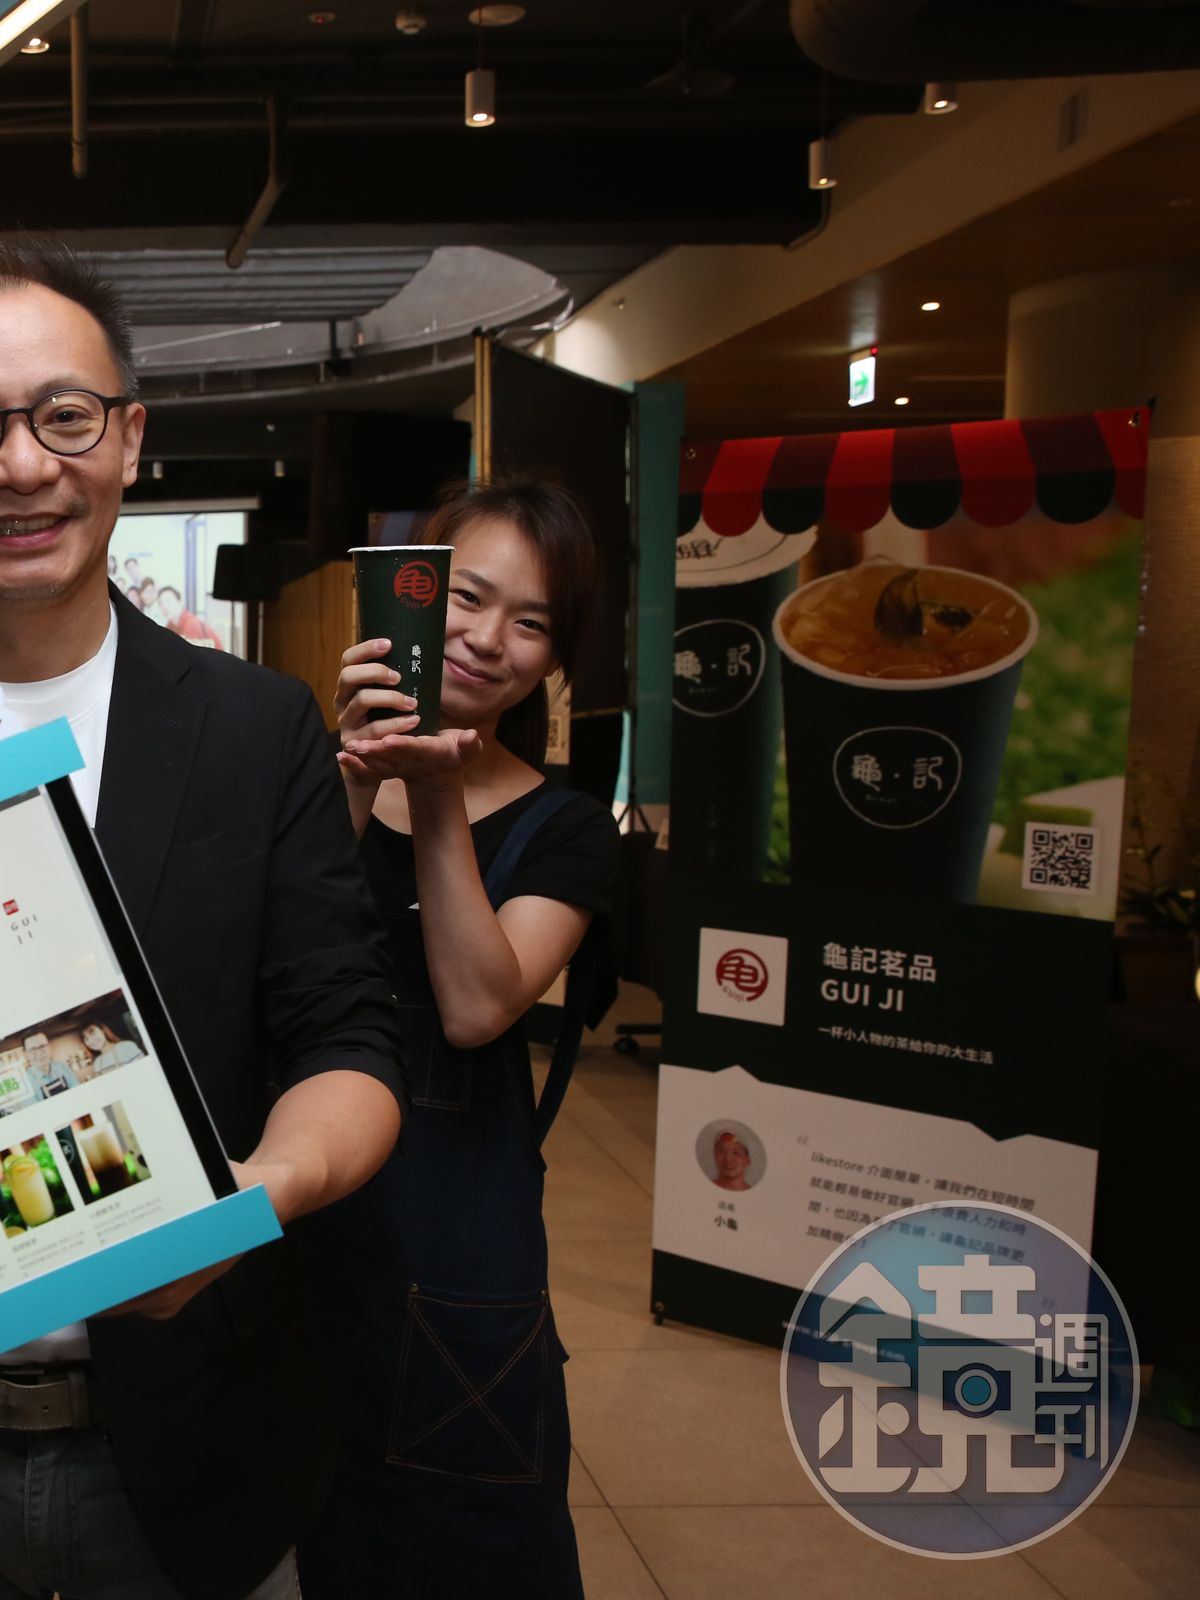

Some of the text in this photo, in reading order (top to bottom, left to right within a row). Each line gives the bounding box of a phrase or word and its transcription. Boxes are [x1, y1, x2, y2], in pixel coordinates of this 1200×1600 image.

[822, 941, 937, 983] 龜記茗品
[820, 979, 904, 1012] GUI JI
[810, 1151, 865, 1173] likestore
